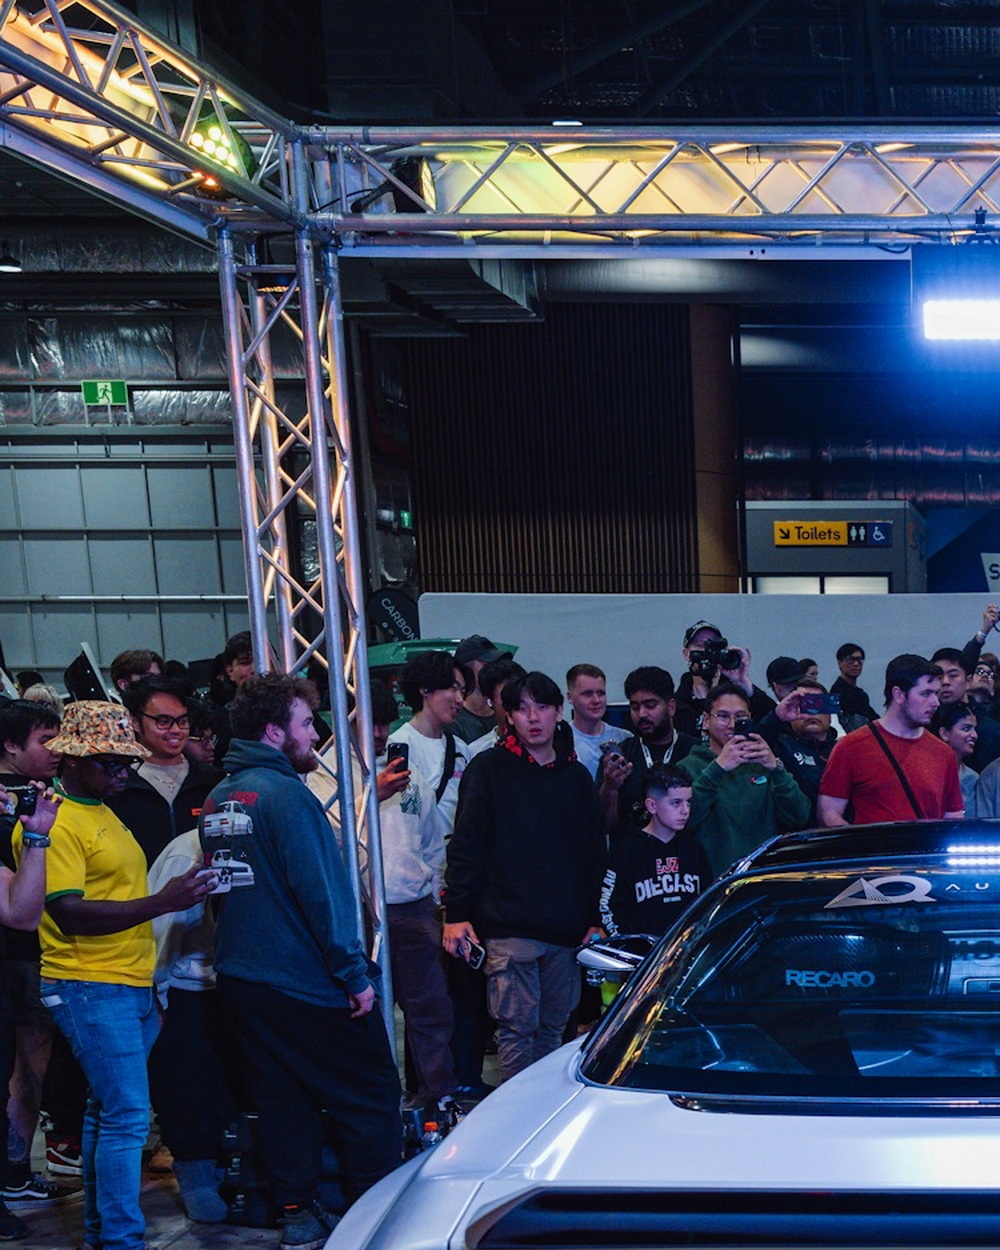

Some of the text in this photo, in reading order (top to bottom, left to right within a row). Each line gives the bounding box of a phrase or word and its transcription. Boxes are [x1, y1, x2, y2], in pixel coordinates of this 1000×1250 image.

[795, 525, 841, 541] Toilets
[634, 873, 700, 903] DIECAST
[785, 969, 875, 989] RECARO
